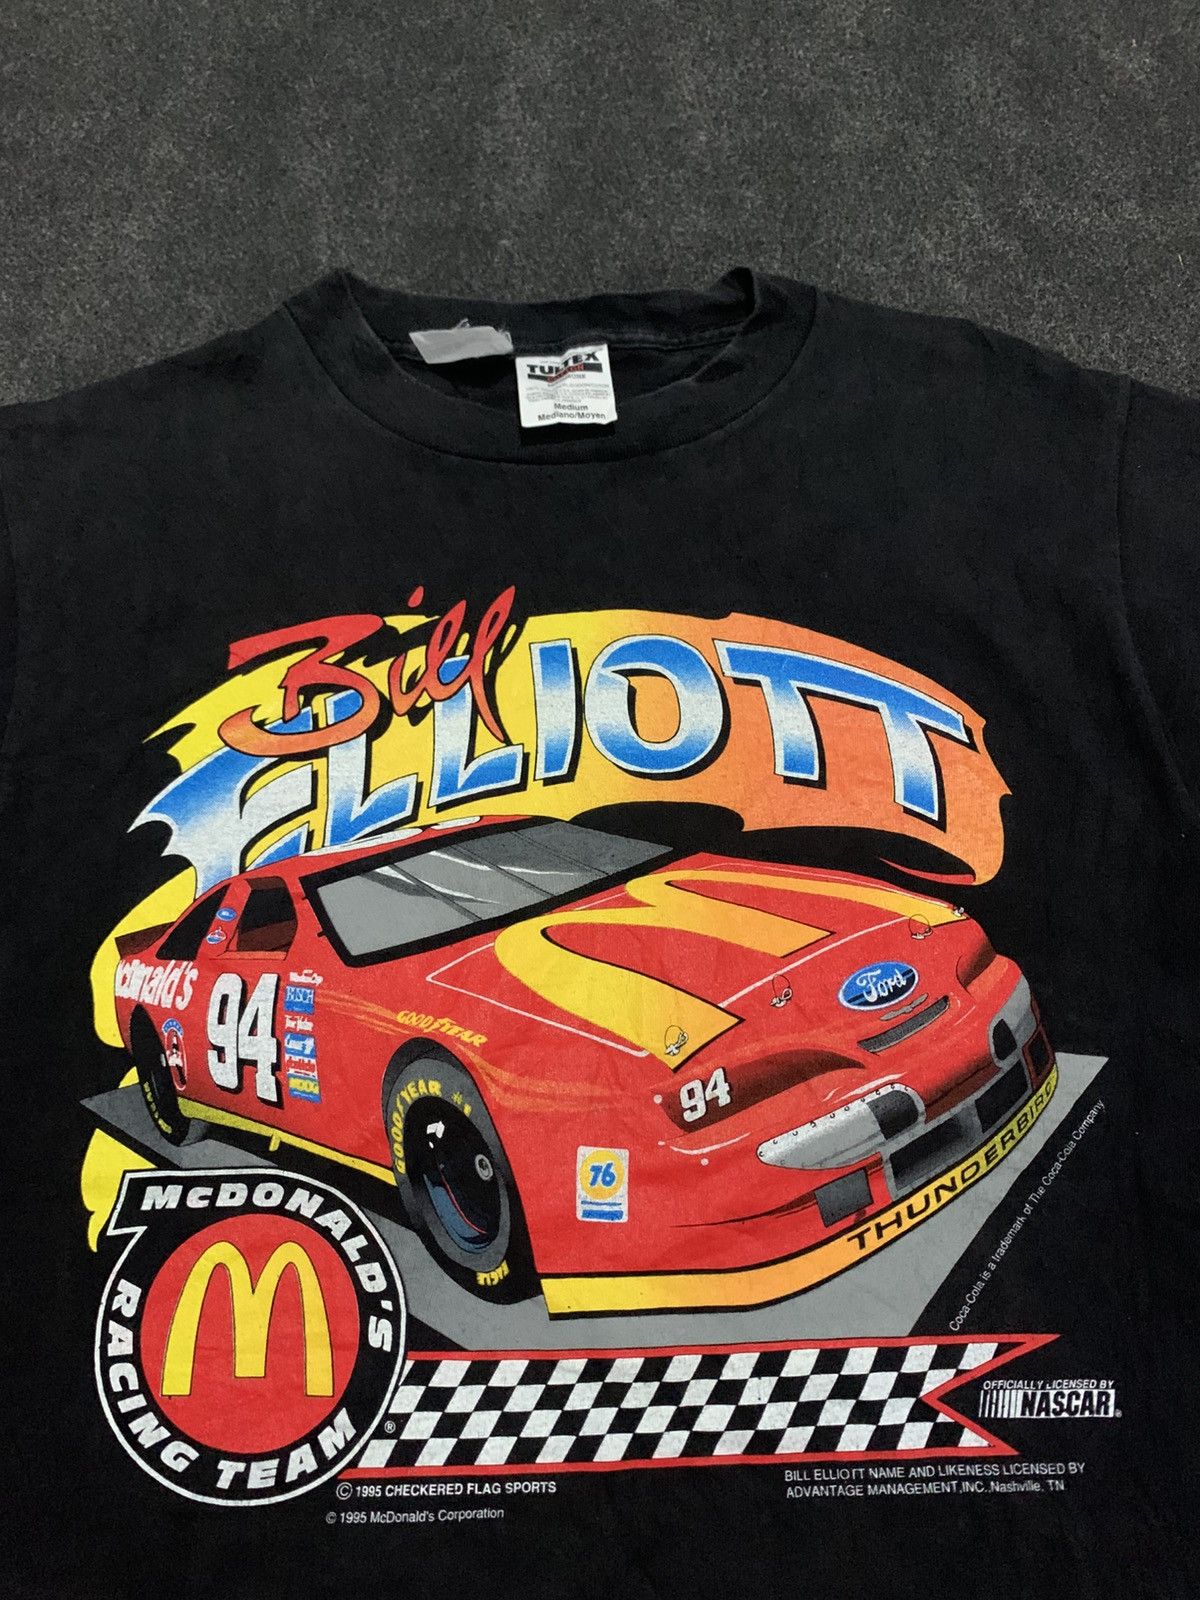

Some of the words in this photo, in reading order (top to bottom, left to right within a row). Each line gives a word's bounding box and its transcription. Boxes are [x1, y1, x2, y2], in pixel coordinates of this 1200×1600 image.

[554, 403, 588, 411] Medium
[218, 585, 516, 757] Bill
[127, 634, 970, 900] ELLIOTT
[856, 969, 907, 1003] Ford
[207, 972, 282, 1103] 94
[396, 1010, 488, 1048] GOODYEAR
[680, 1067, 731, 1123] 94
[589, 1162, 616, 1187] 76
[847, 1081, 1053, 1251] THUNDERBIRD
[949, 1279, 986, 1332] Coca-Cola
[993, 1214, 1027, 1263] trademark
[1028, 1186, 1046, 1204] The
[1042, 1140, 1077, 1187] Coca-Cola
[1072, 1099, 1105, 1141] Company
[141, 1182, 393, 1352] McDONALD'S
[107, 1278, 200, 1473] RACING
[983, 1380, 1043, 1390] OFFICIALLY
[1046, 1379, 1097, 1389] LICENSED
[1100, 1380, 1114, 1389] BY
[1020, 1391, 1111, 1416] NASCAR
[216, 1407, 357, 1490] TEAM
[356, 1485, 382, 1497] 1995
[385, 1483, 463, 1496] CHECKERED
[467, 1482, 501, 1495] FLAG
[505, 1481, 557, 1494] SPORTS
[784, 1469, 811, 1482] BILL
[814, 1467, 865, 1481] ELLIOTT
[869, 1467, 905, 1479] NAME
[909, 1465, 935, 1478] AND
[938, 1463, 1000, 1477] LIKENESS
[1003, 1462, 1065, 1476] LICENSED
[1068, 1462, 1086, 1474] BY
[786, 1484, 864, 1499] ADVANTAGE
[1046, 1479, 1065, 1491] TN
[340, 1512, 367, 1523] 1995
[370, 1510, 435, 1523] McDonald's
[438, 1507, 505, 1522] Corporation
